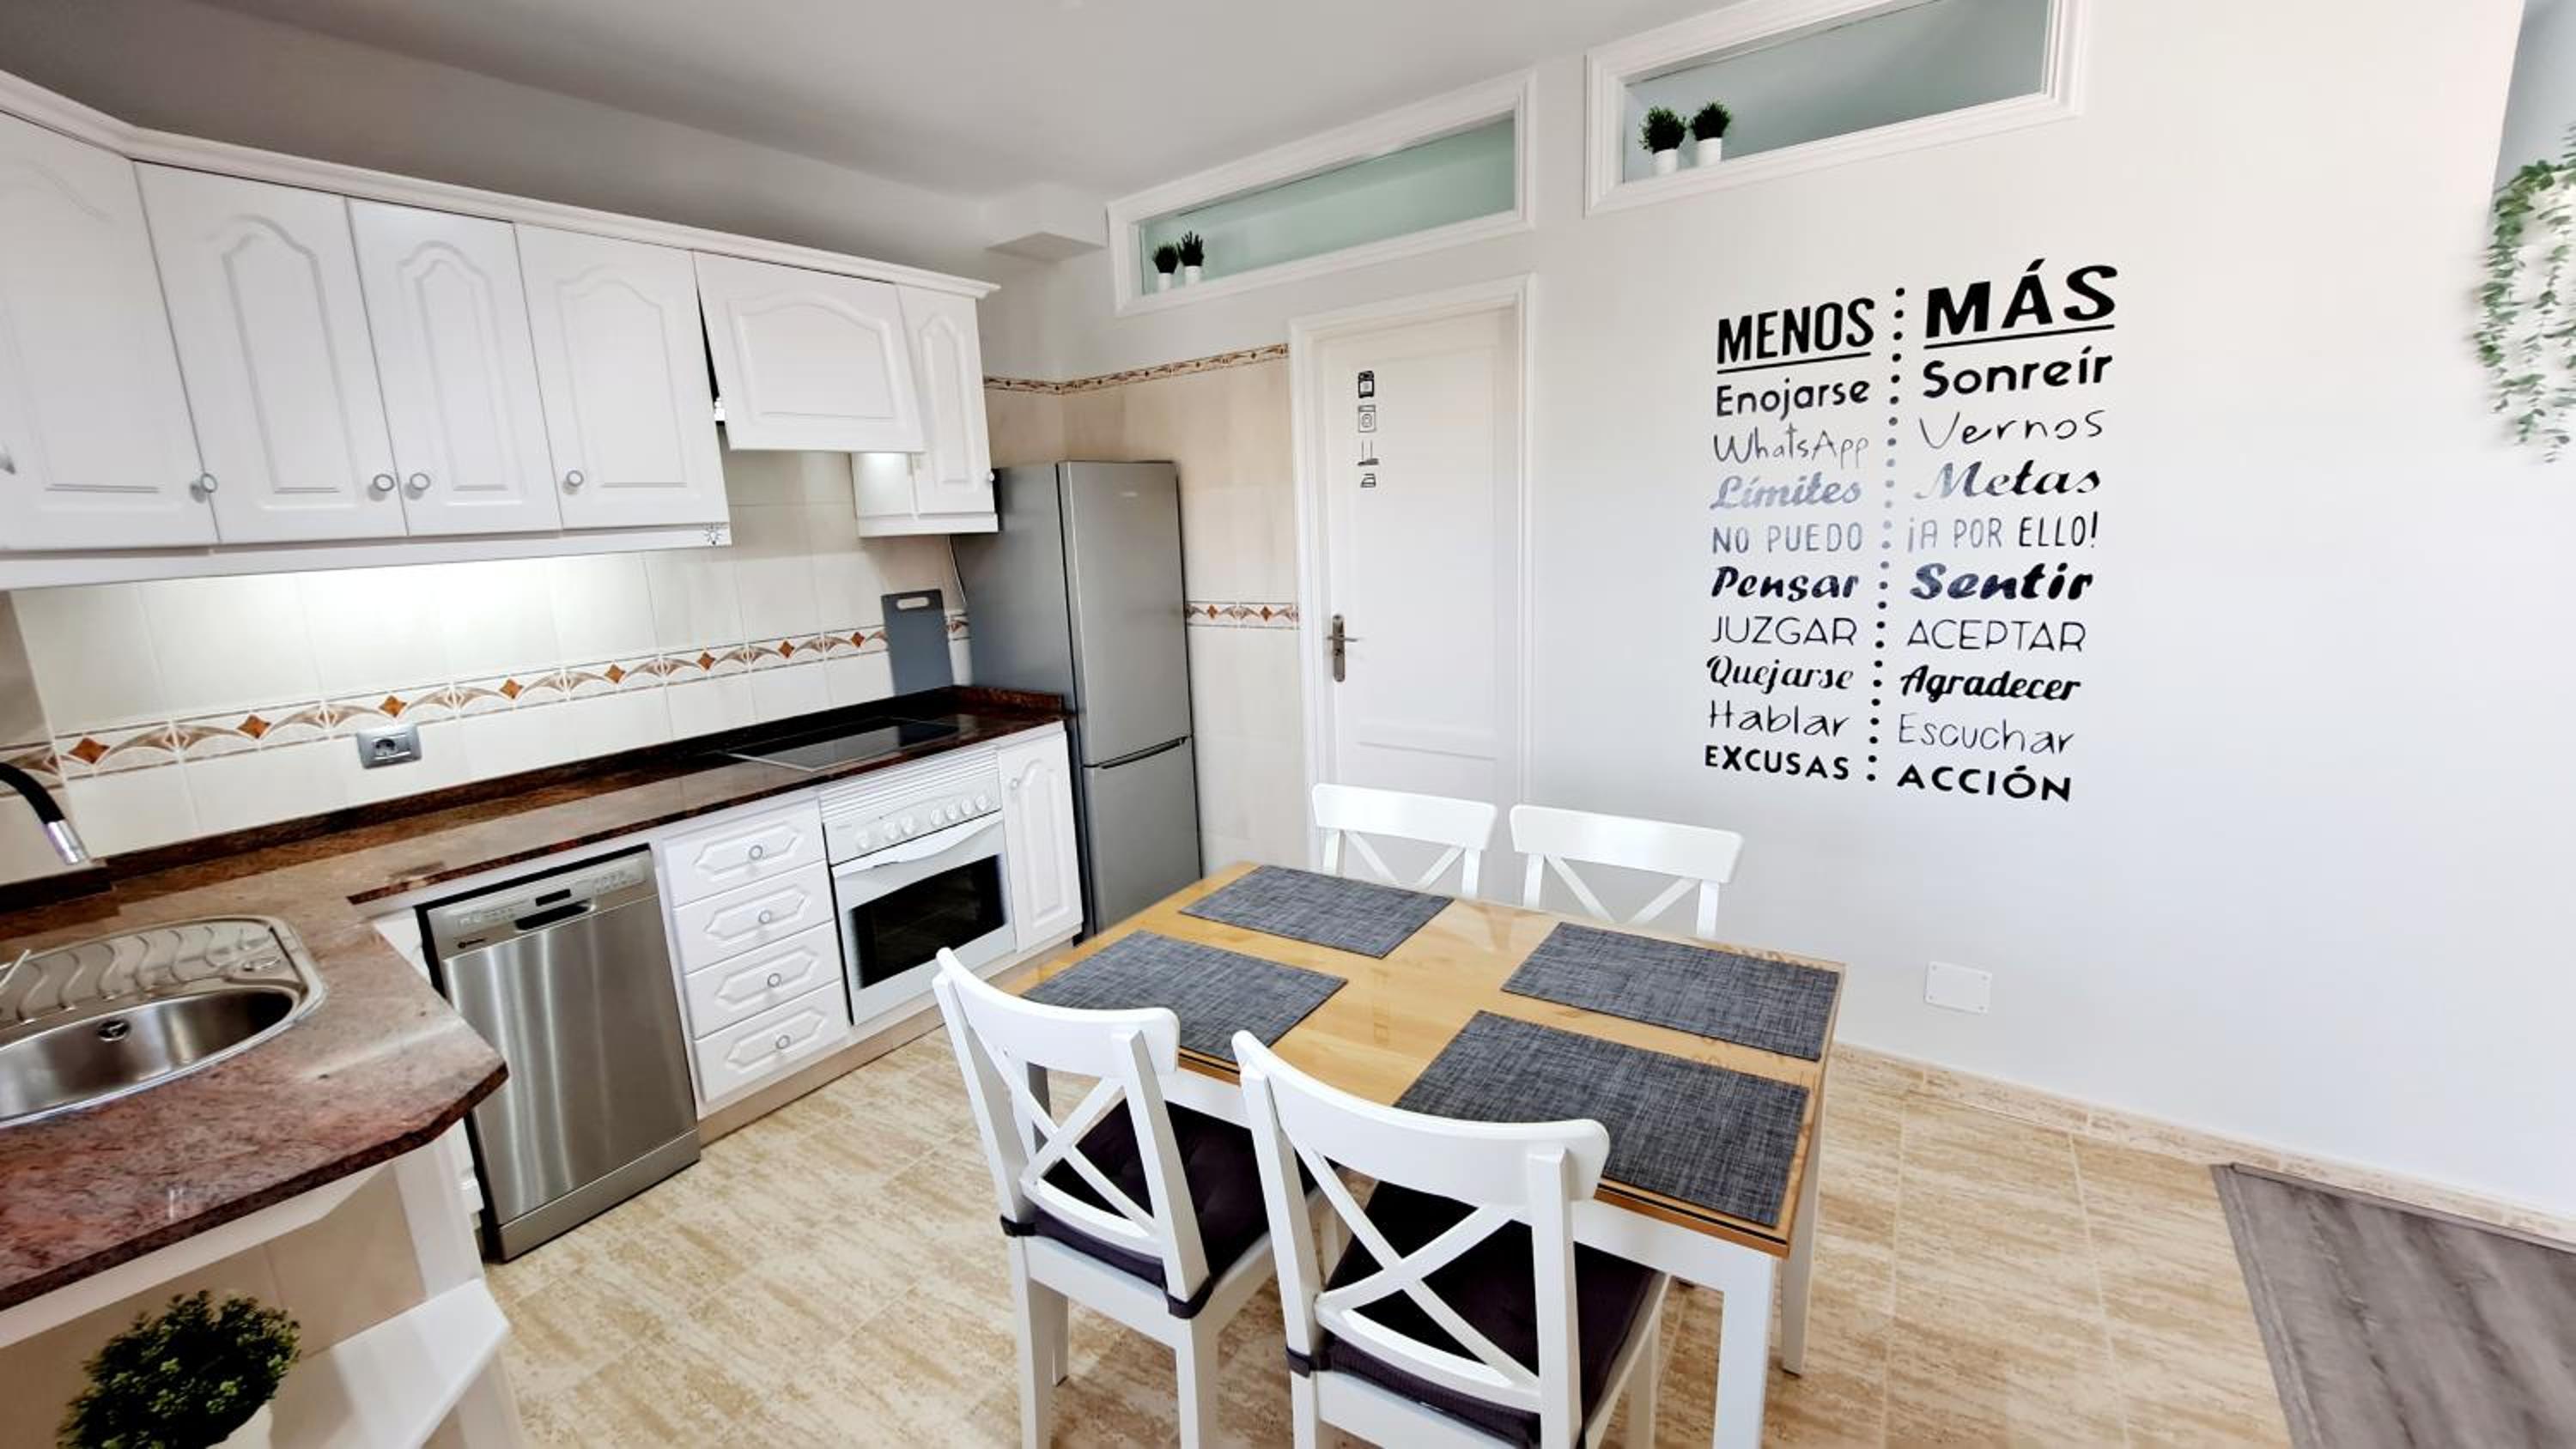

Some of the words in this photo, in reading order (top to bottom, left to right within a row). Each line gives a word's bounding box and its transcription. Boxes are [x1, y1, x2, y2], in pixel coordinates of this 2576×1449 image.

[1924, 258, 2118, 339] MÁS
[1716, 296, 1876, 365] MENOS
[1922, 345, 2113, 399] Sonreír
[1716, 377, 1871, 422] Enojarse
[1713, 421, 1869, 470] WhatsApp
[1918, 409, 2106, 450] Vernos
[1709, 471, 1862, 510] Límites
[1914, 458, 2101, 500] Metas
[1712, 525, 1750, 555] NO
[1767, 521, 1863, 554] PUEDO
[1953, 516, 2002, 549] POR
[2018, 509, 2099, 549] ELLO!
[1710, 565, 1860, 603] Pensar
[1909, 561, 2094, 602] Sentir
[1710, 615, 1858, 646] JUZGAR
[1905, 618, 2087, 652] ACEPTAR
[1705, 653, 1854, 695] Quejarse
[1899, 664, 2082, 704] Agradecer
[1709, 699, 1850, 740] Hablar
[1899, 712, 2075, 755] Escuchar
[1704, 743, 1850, 783] EXCUSAS
[1896, 764, 2071, 803] ACCIÓN
